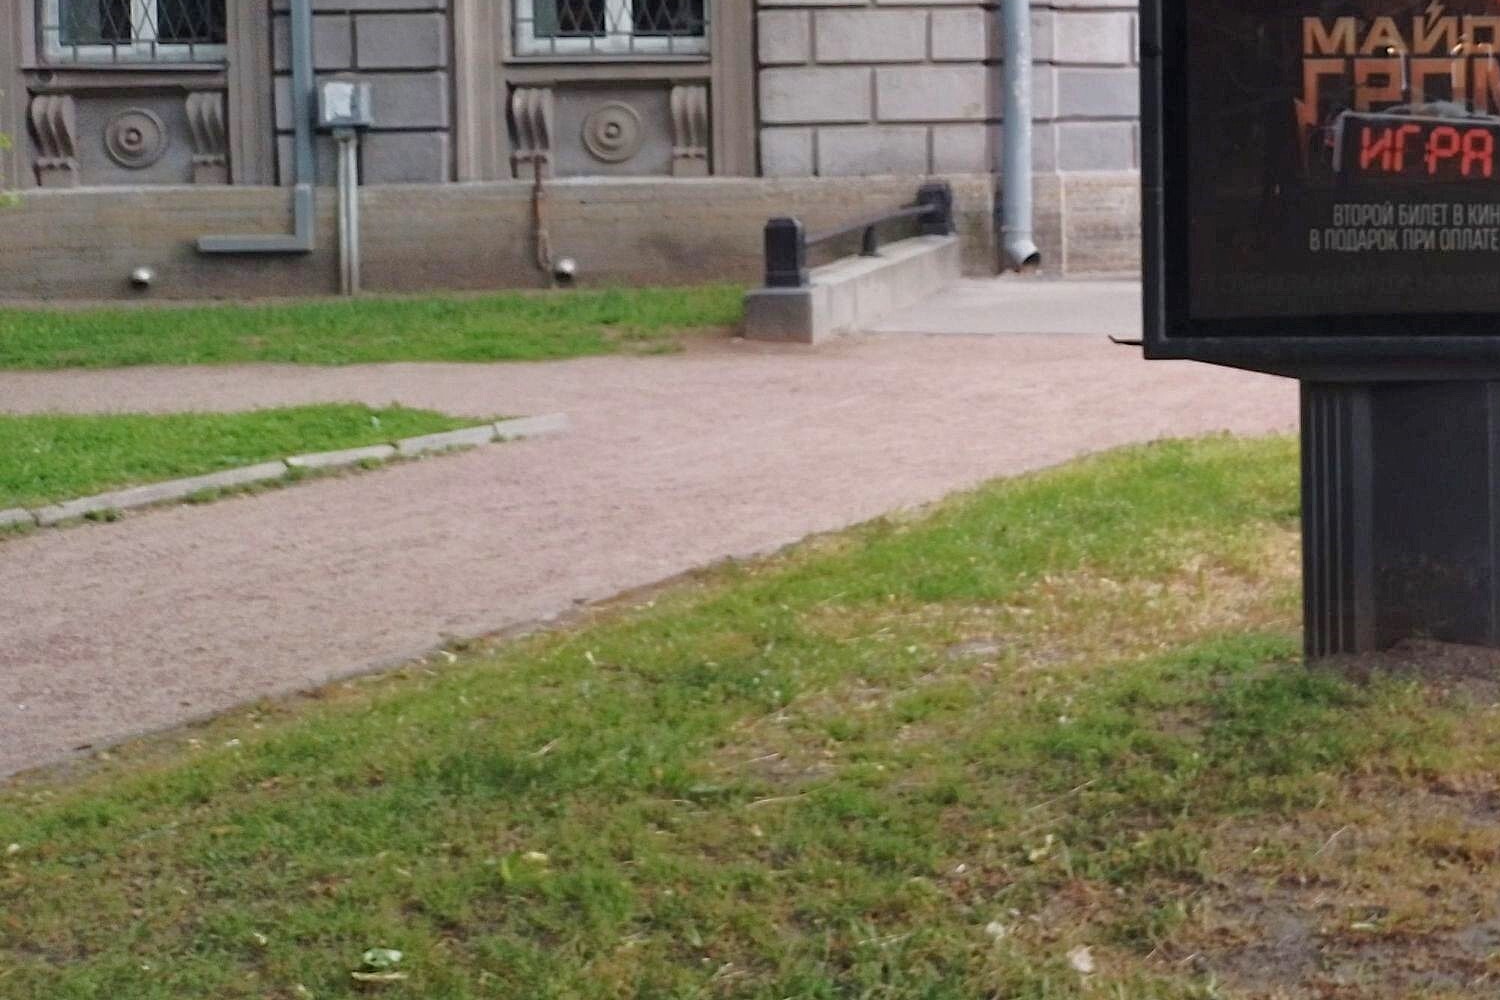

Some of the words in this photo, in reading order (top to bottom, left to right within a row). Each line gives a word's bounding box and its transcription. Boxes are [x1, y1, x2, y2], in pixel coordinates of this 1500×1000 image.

[1359, 124, 1494, 178] ИГРА
[1332, 201, 1394, 226] ВТОРОЙ
[1398, 203, 1447, 226] БИЛЕТ
[1452, 203, 1463, 225] В
[1309, 228, 1320, 251] В
[1324, 228, 1399, 252] ПОДАРОК
[1402, 228, 1436, 251] ПРИ
[1440, 228, 1499, 251] ОПЛАТЕ
